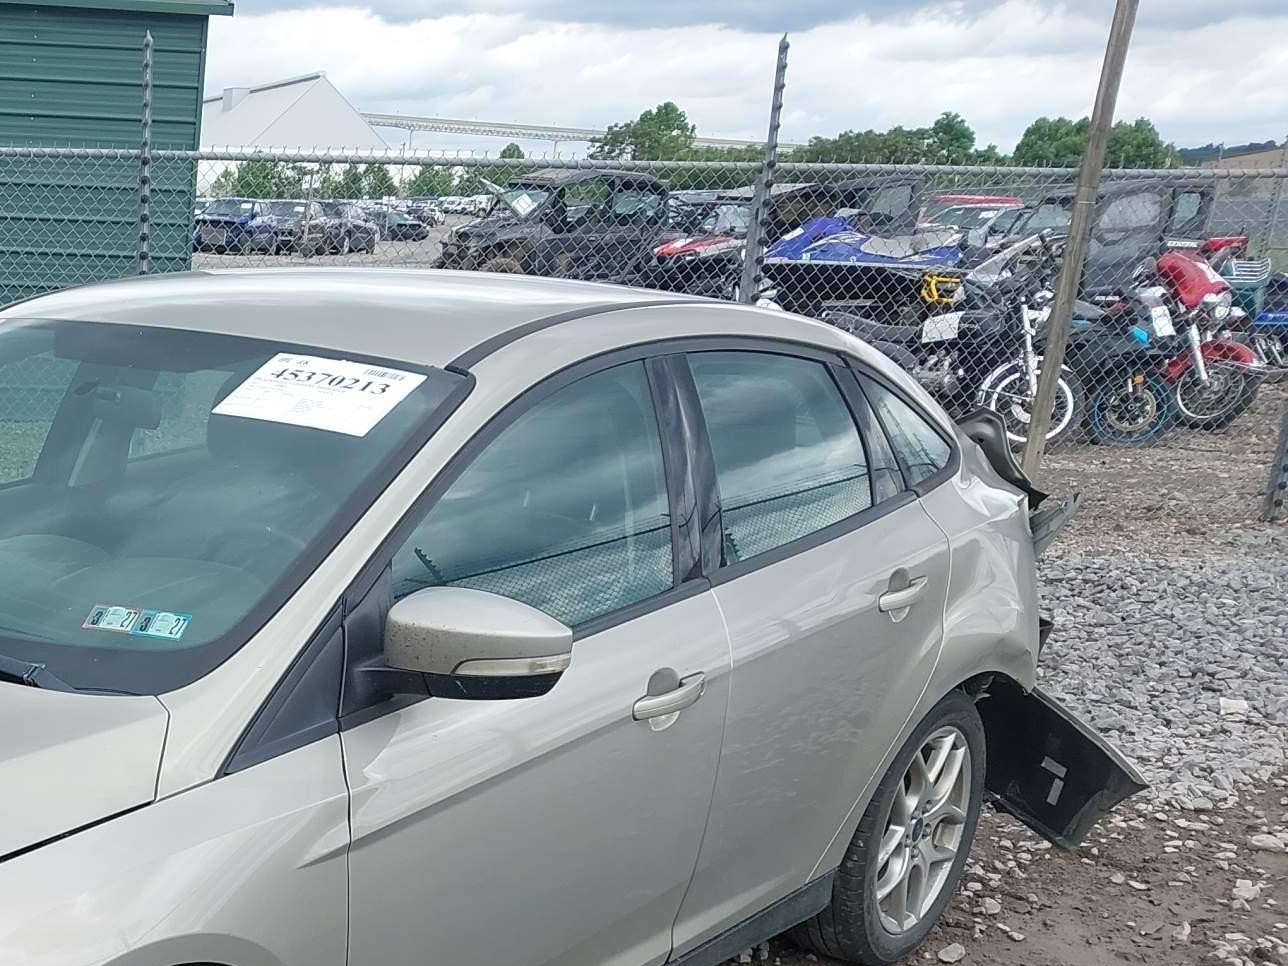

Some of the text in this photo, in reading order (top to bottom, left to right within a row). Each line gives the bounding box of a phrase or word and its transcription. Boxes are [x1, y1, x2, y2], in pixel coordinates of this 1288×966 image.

[270, 367, 391, 395] 45370213
[91, 611, 138, 629] 3 27
[140, 617, 187, 635] 3 27
